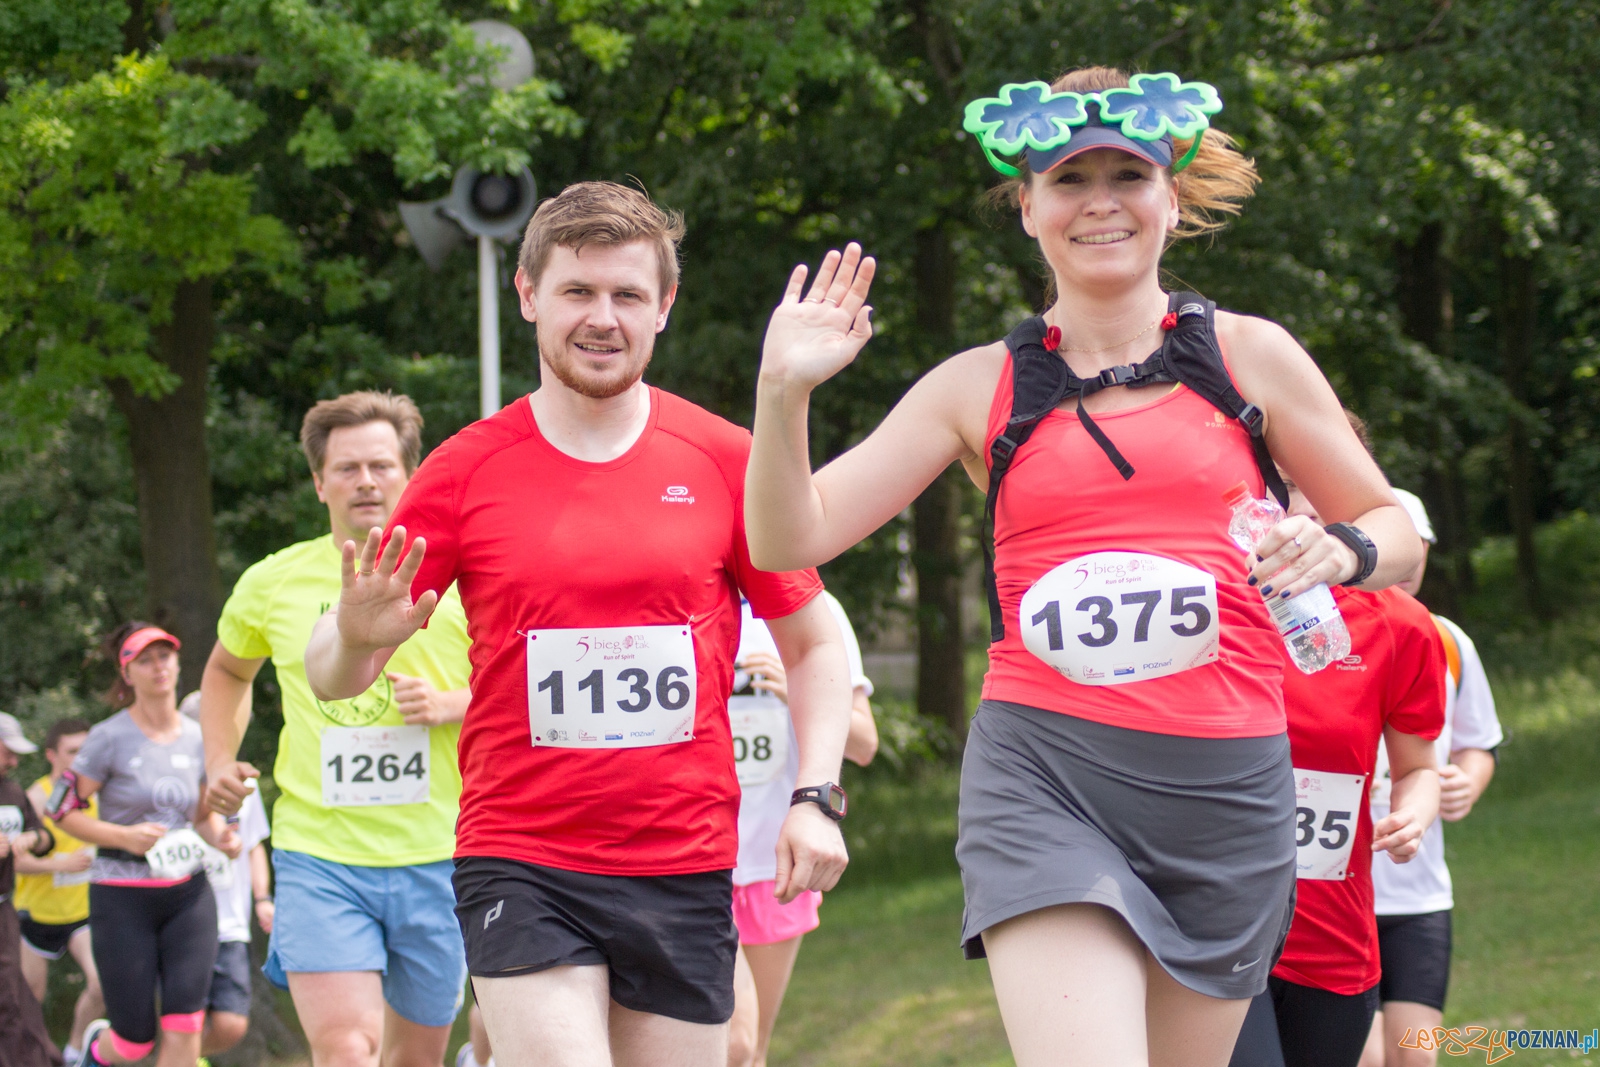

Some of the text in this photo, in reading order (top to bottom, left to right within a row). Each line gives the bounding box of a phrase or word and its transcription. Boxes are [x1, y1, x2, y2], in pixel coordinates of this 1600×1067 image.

[661, 495, 695, 505] Kalenji
[1073, 562, 1126, 590] 5 bieg
[1125, 576, 1142, 584] Spirit
[1031, 585, 1211, 651] 1375
[1304, 618, 1318, 629] 956
[575, 635, 622, 662] 5 bieg
[635, 641, 650, 649] tak
[537, 665, 691, 714] 1136
[733, 735, 771, 762] 08
[327, 751, 426, 783] 1264
[1296, 806, 1351, 850] 35
[154, 843, 205, 867] 1505
